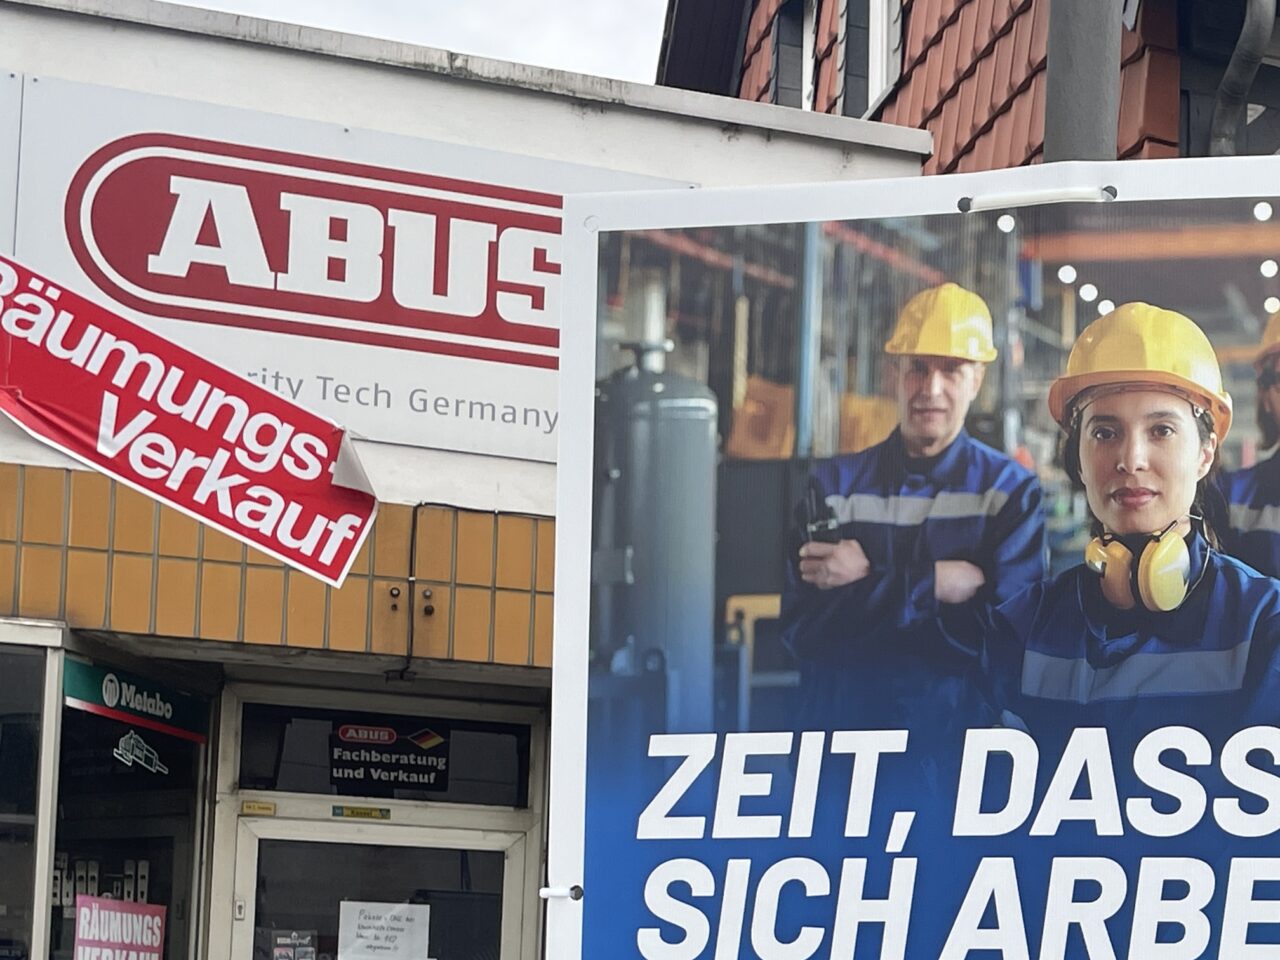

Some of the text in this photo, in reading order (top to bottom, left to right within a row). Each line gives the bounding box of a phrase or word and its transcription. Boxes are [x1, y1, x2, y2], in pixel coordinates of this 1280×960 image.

[147, 175, 561, 329] ABUS
[316, 375, 391, 409] Tech
[409, 388, 559, 434] Germany
[97, 390, 362, 566] Verkauf
[121, 682, 172, 719] Metabo
[346, 728, 389, 741] ABUS
[332, 767, 436, 784] und Verkauf
[333, 747, 447, 770] Fachberatung
[635, 728, 915, 853] ZEIT,
[79, 903, 162, 948] RÄUMUNGS
